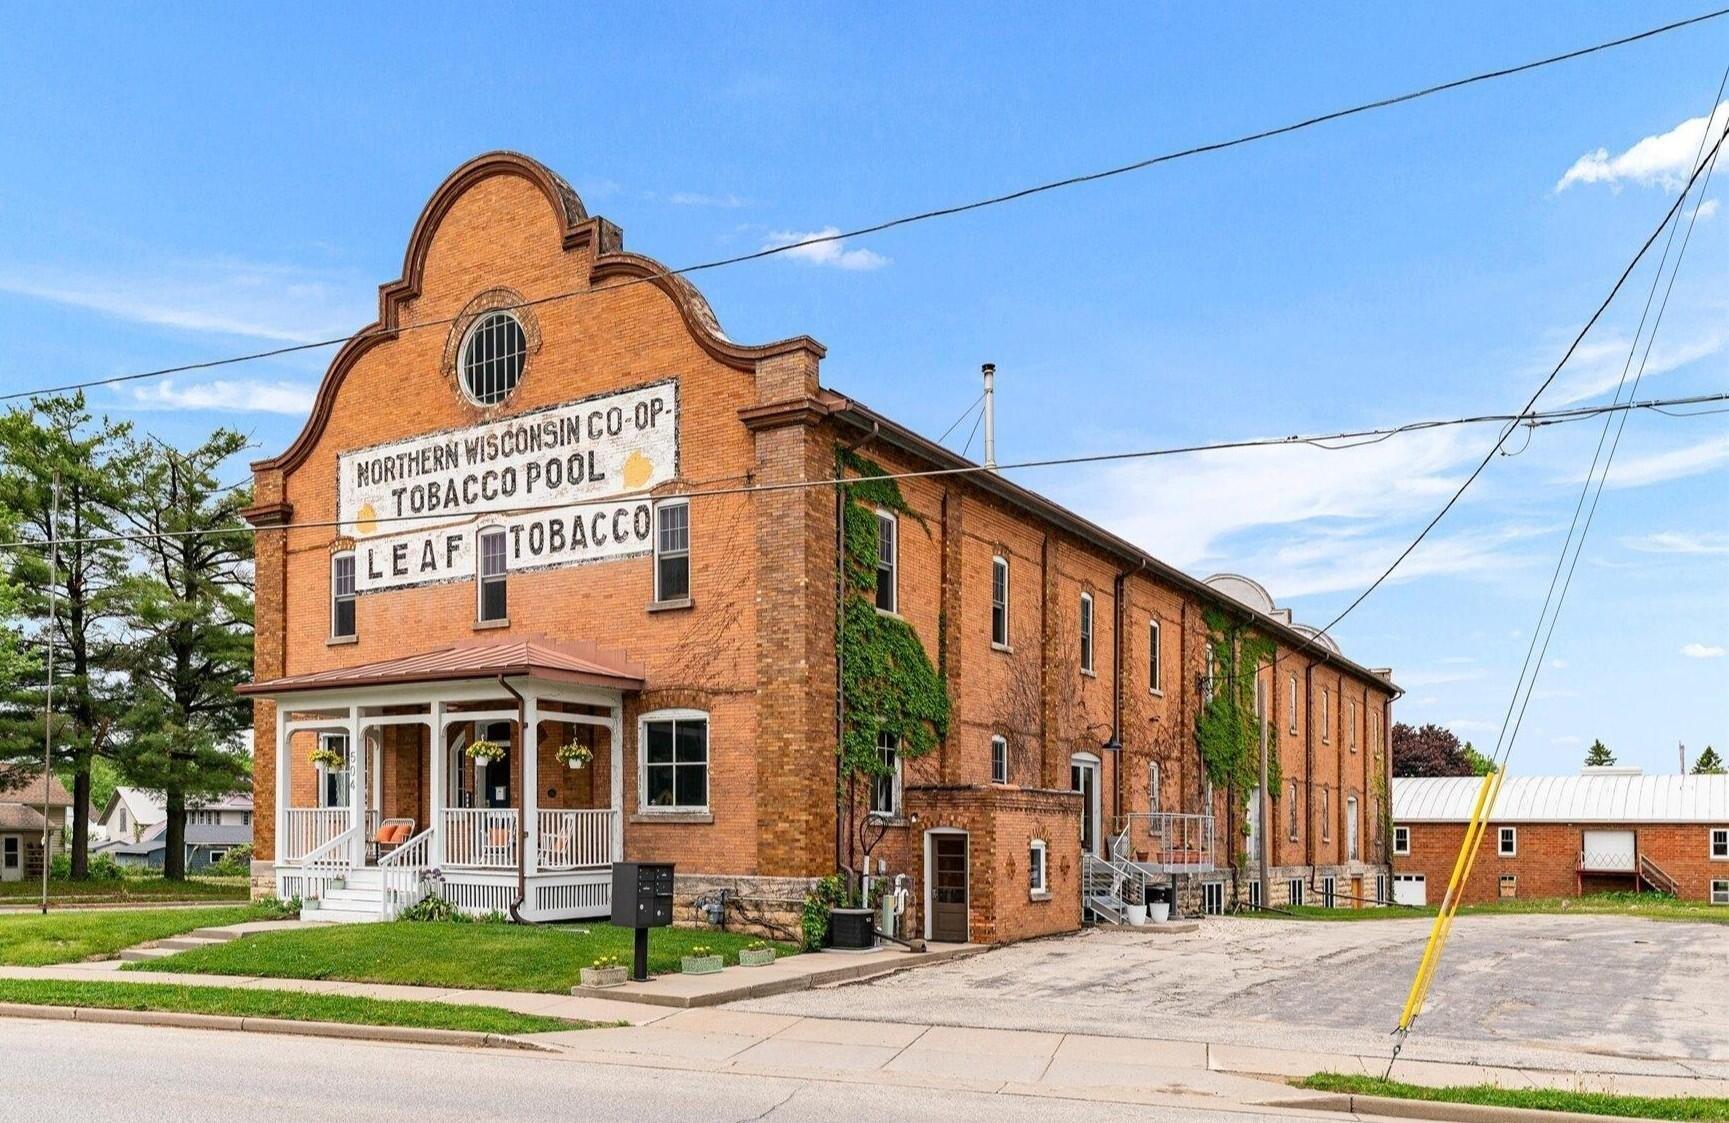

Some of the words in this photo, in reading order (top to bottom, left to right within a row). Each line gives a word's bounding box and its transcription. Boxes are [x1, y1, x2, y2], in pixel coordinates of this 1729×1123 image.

[357, 443, 459, 488] NORTHERN
[464, 415, 580, 463] WISCONSIN
[391, 465, 517, 517] TOBACCO
[526, 450, 605, 494] POOL
[367, 534, 463, 580] LEAF
[509, 503, 651, 559] TOBACCO
